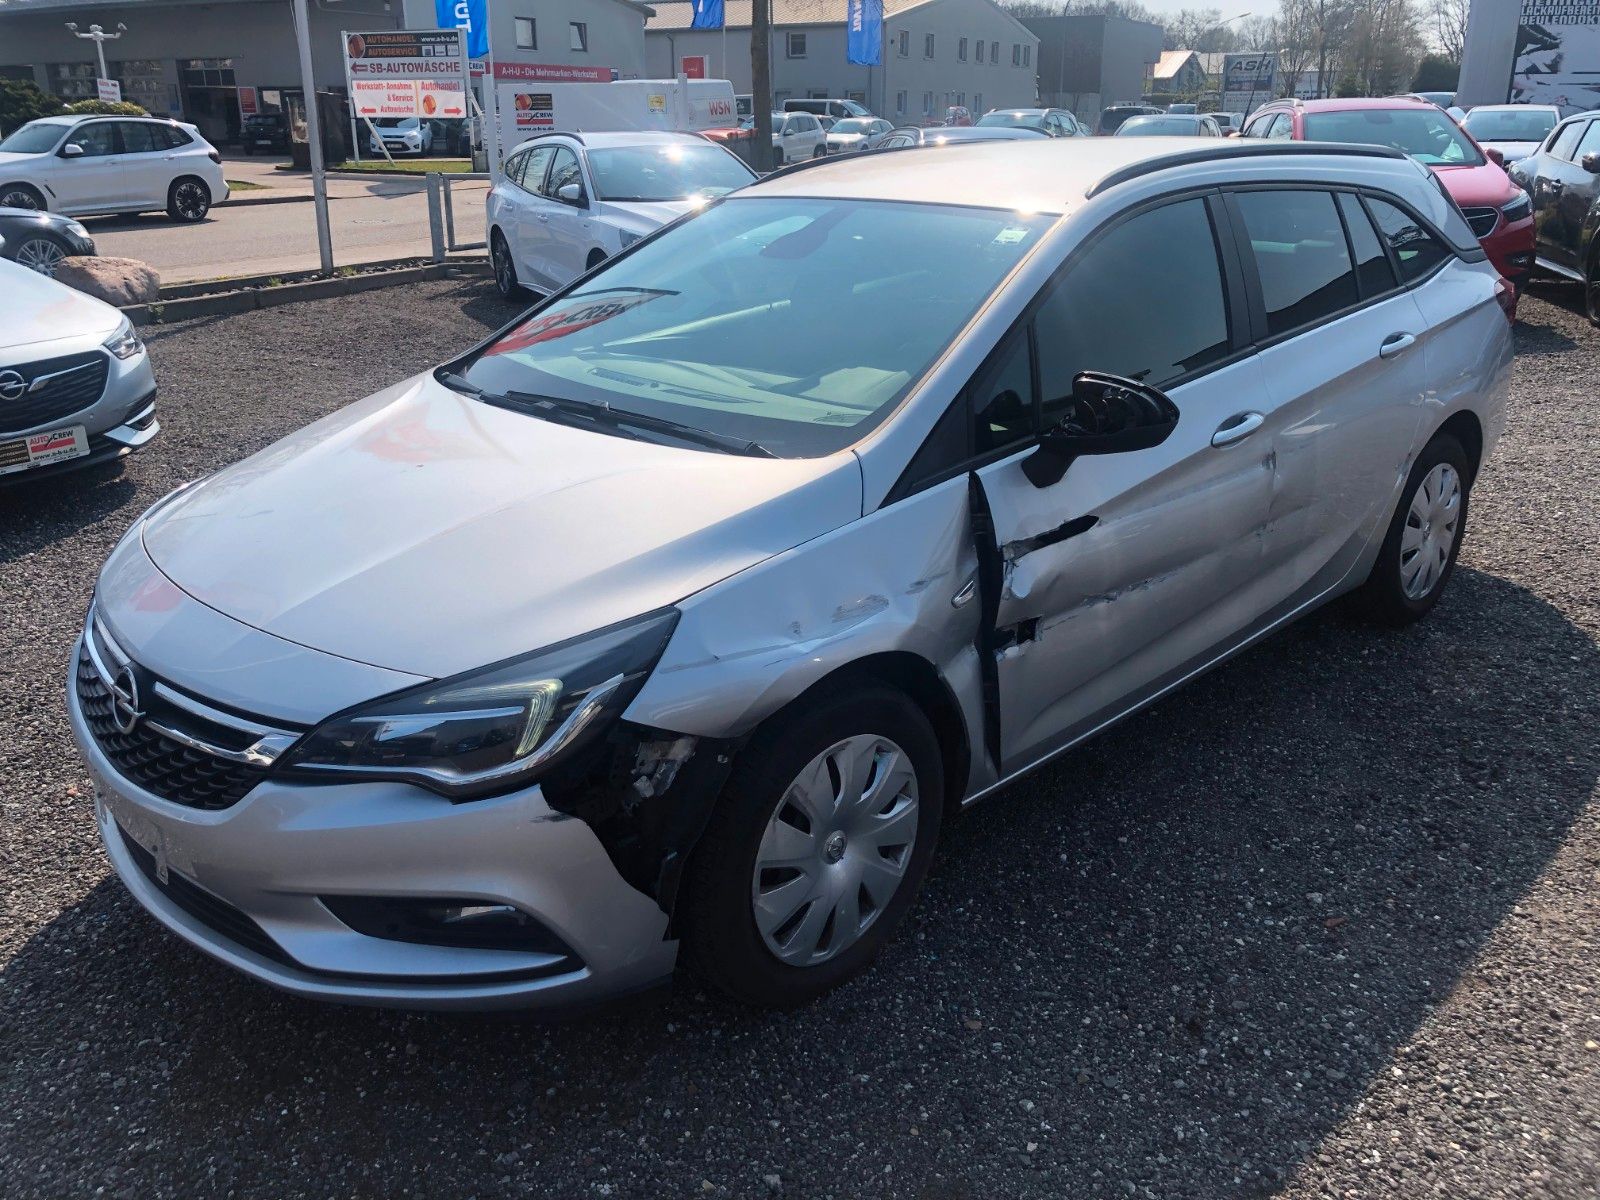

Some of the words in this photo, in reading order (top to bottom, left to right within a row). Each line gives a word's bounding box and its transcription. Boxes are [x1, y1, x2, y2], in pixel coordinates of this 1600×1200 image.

[367, 35, 417, 43] AUTOHANDEL
[368, 48, 417, 56] AUTOSERVICE
[369, 60, 461, 73] SB-AUTOWÄSCHE
[1231, 60, 1271, 71] ASH
[501, 66, 520, 76] A-H-U
[525, 67, 535, 76] Die
[536, 68, 598, 79] Mehrmarken-Werkstatt
[421, 81, 460, 91] Autohandel
[392, 94, 414, 102] Service
[708, 100, 731, 116] WSN
[29, 435, 49, 445] AUTO
[52, 430, 74, 441] CREW
[33, 447, 77, 461] www.a-h-u.de
